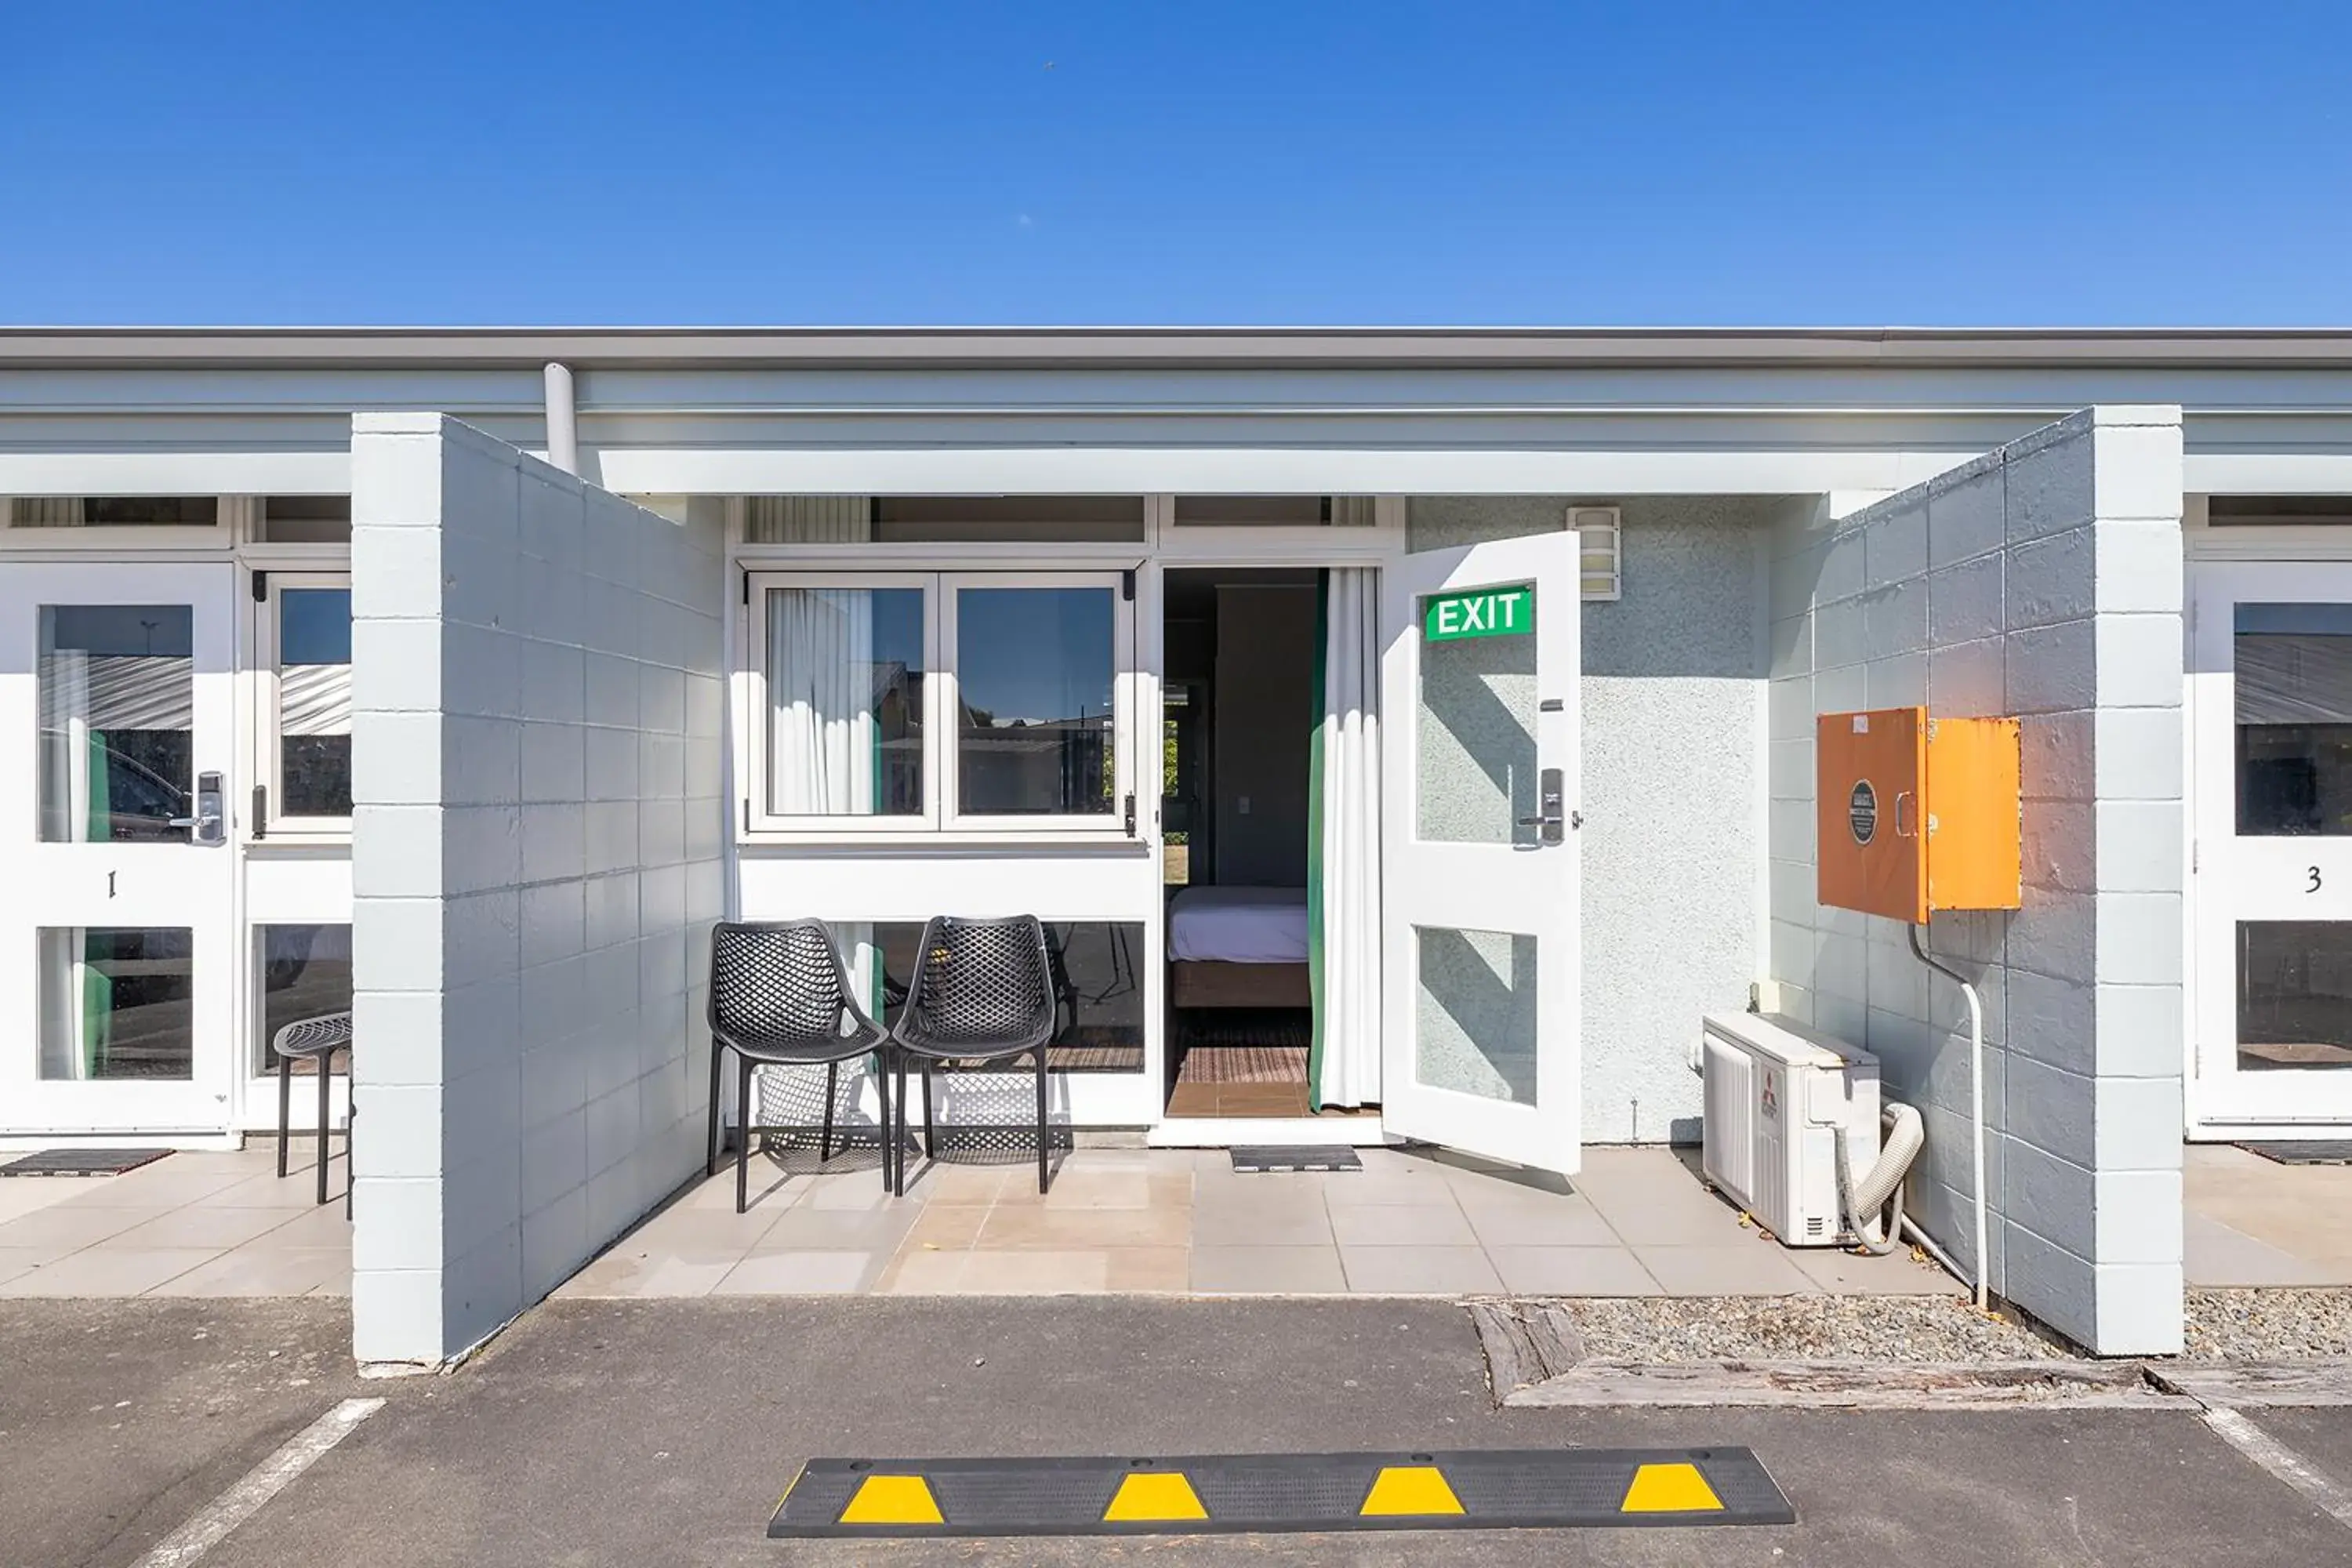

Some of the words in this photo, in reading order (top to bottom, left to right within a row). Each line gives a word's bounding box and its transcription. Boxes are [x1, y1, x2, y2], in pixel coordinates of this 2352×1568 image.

[1439, 593, 1521, 634] EXIT
[108, 869, 117, 900] 1
[2305, 866, 2321, 894] 3
